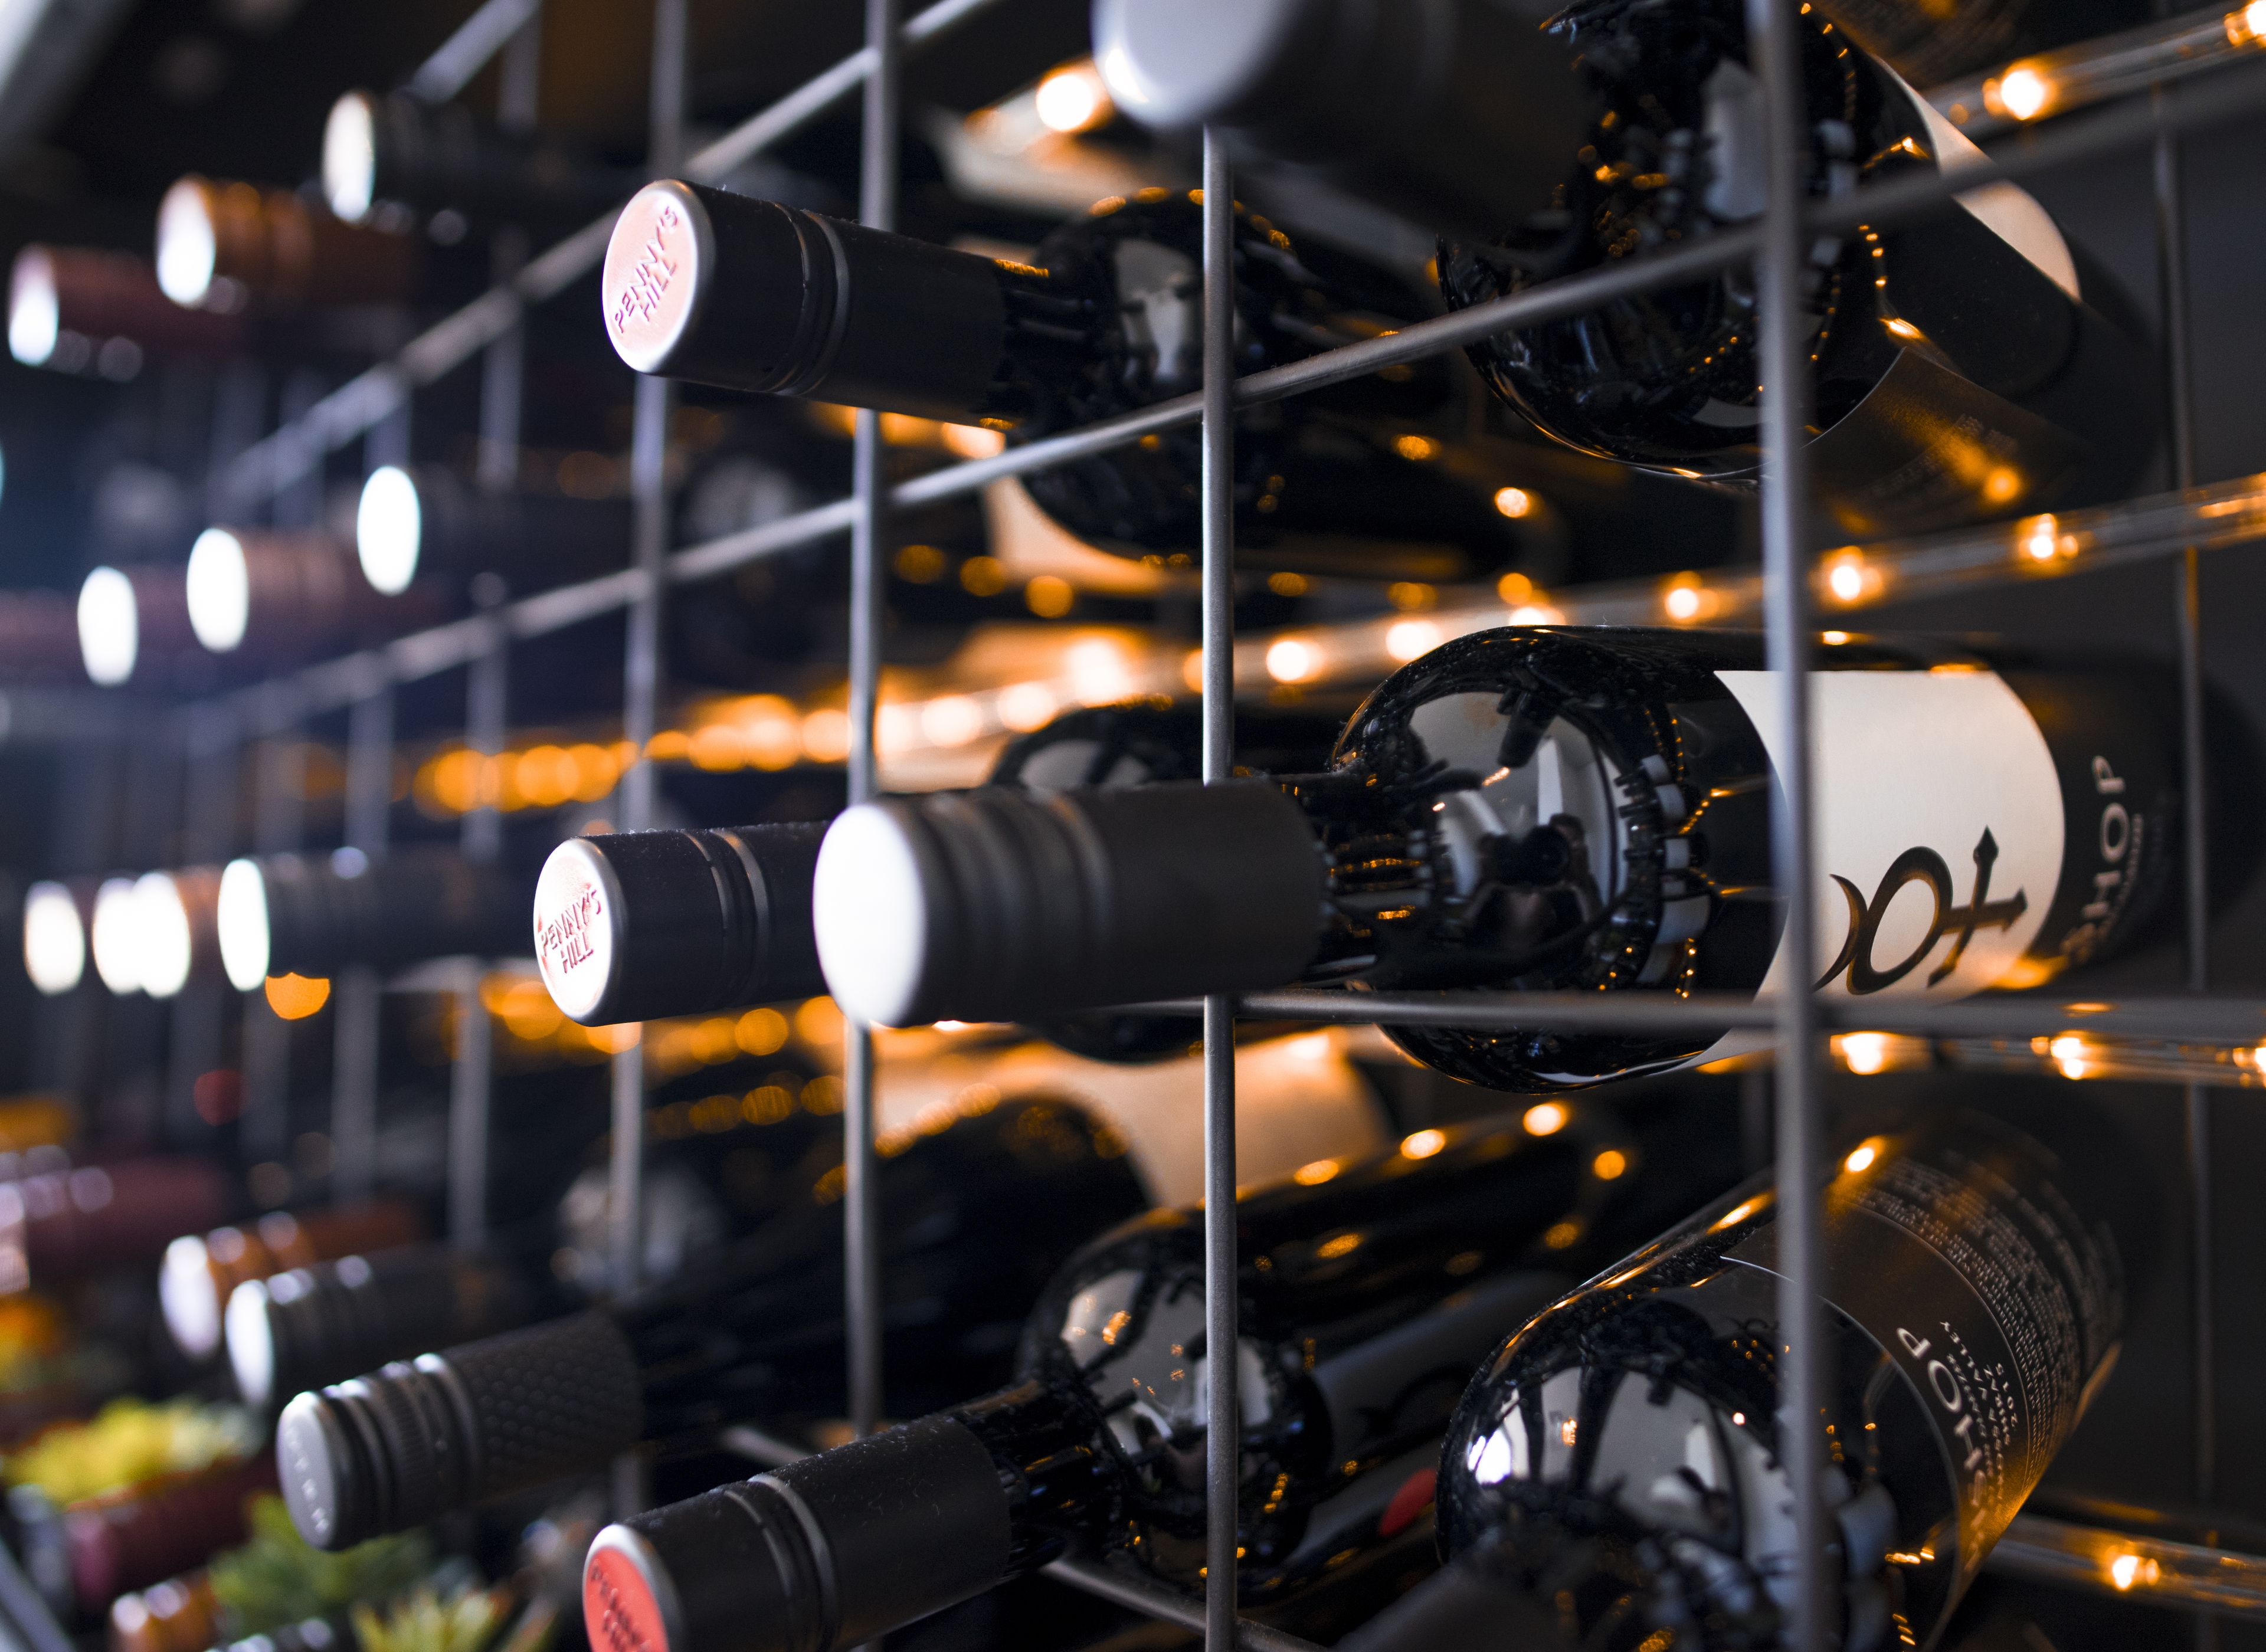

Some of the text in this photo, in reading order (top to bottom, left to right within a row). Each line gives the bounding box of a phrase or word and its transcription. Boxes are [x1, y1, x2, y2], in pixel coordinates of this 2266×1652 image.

[614, 205, 679, 334] PENNY'S
[642, 258, 677, 322] HILL
[539, 889, 602, 956] PENNY'S
[560, 932, 594, 974] HILL
[1924, 1231, 1944, 1246] of
[1944, 1247, 1972, 1274] wife
[1951, 1233, 2021, 1313] contribution
[1968, 1260, 1989, 1282] the
[1988, 1284, 2002, 1299] in
[2000, 1301, 2033, 1366] tradition
[2016, 1315, 2043, 1376] Judith's
[2026, 1319, 2039, 1340] by
[1940, 1322, 1987, 1401] VALLEY
[2013, 1340, 2033, 1389] Judith
[1984, 1364, 2010, 1446] SHIRAZ
[1996, 1363, 2018, 1431] 2015
[2028, 1391, 2035, 1410] of
